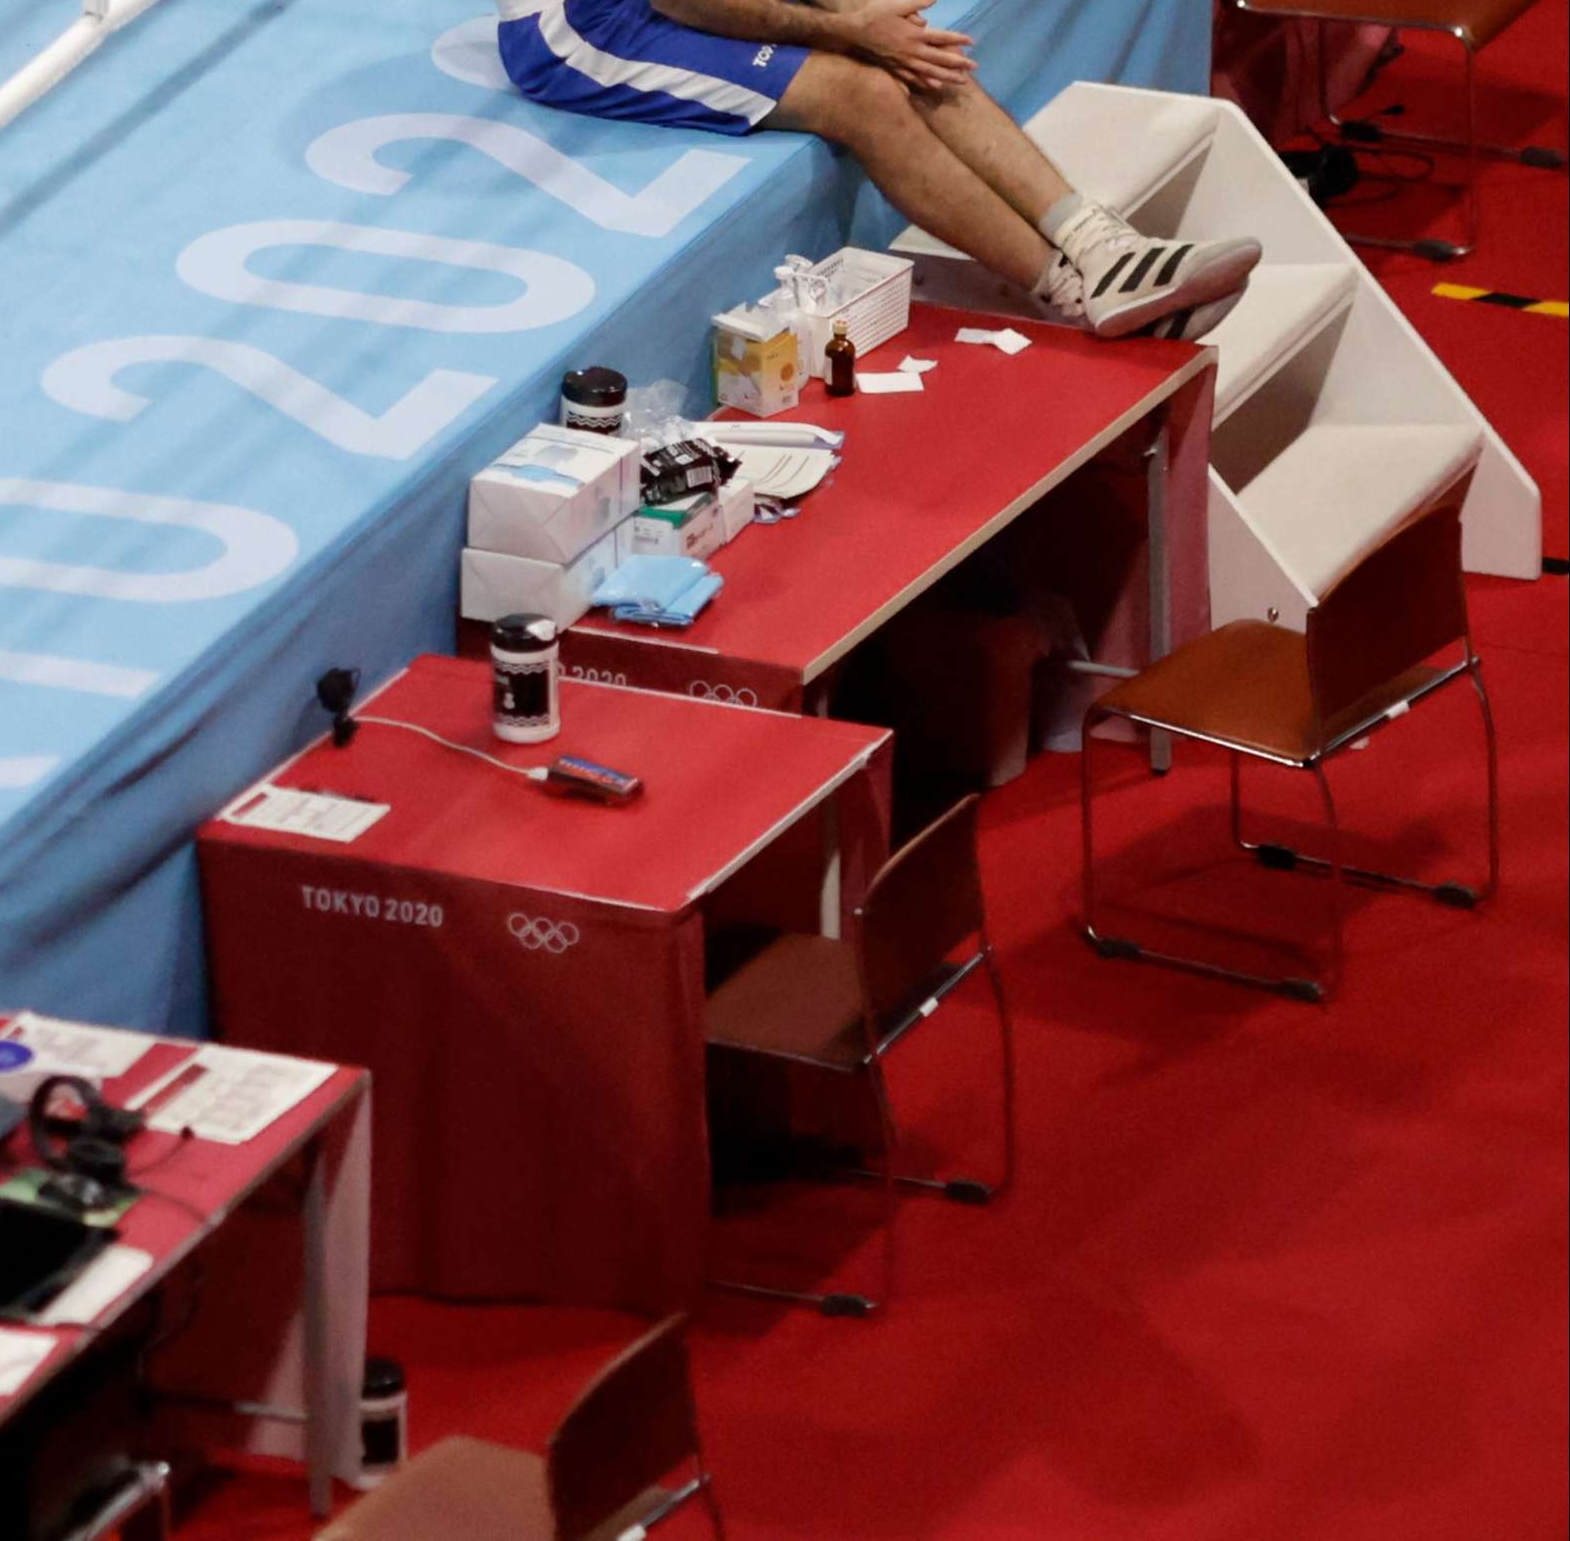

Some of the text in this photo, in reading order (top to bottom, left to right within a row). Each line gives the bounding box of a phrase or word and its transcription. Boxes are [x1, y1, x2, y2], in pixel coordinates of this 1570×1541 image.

[37, 15, 751, 459] 202
[301, 884, 444, 928] TOKYO 2020
